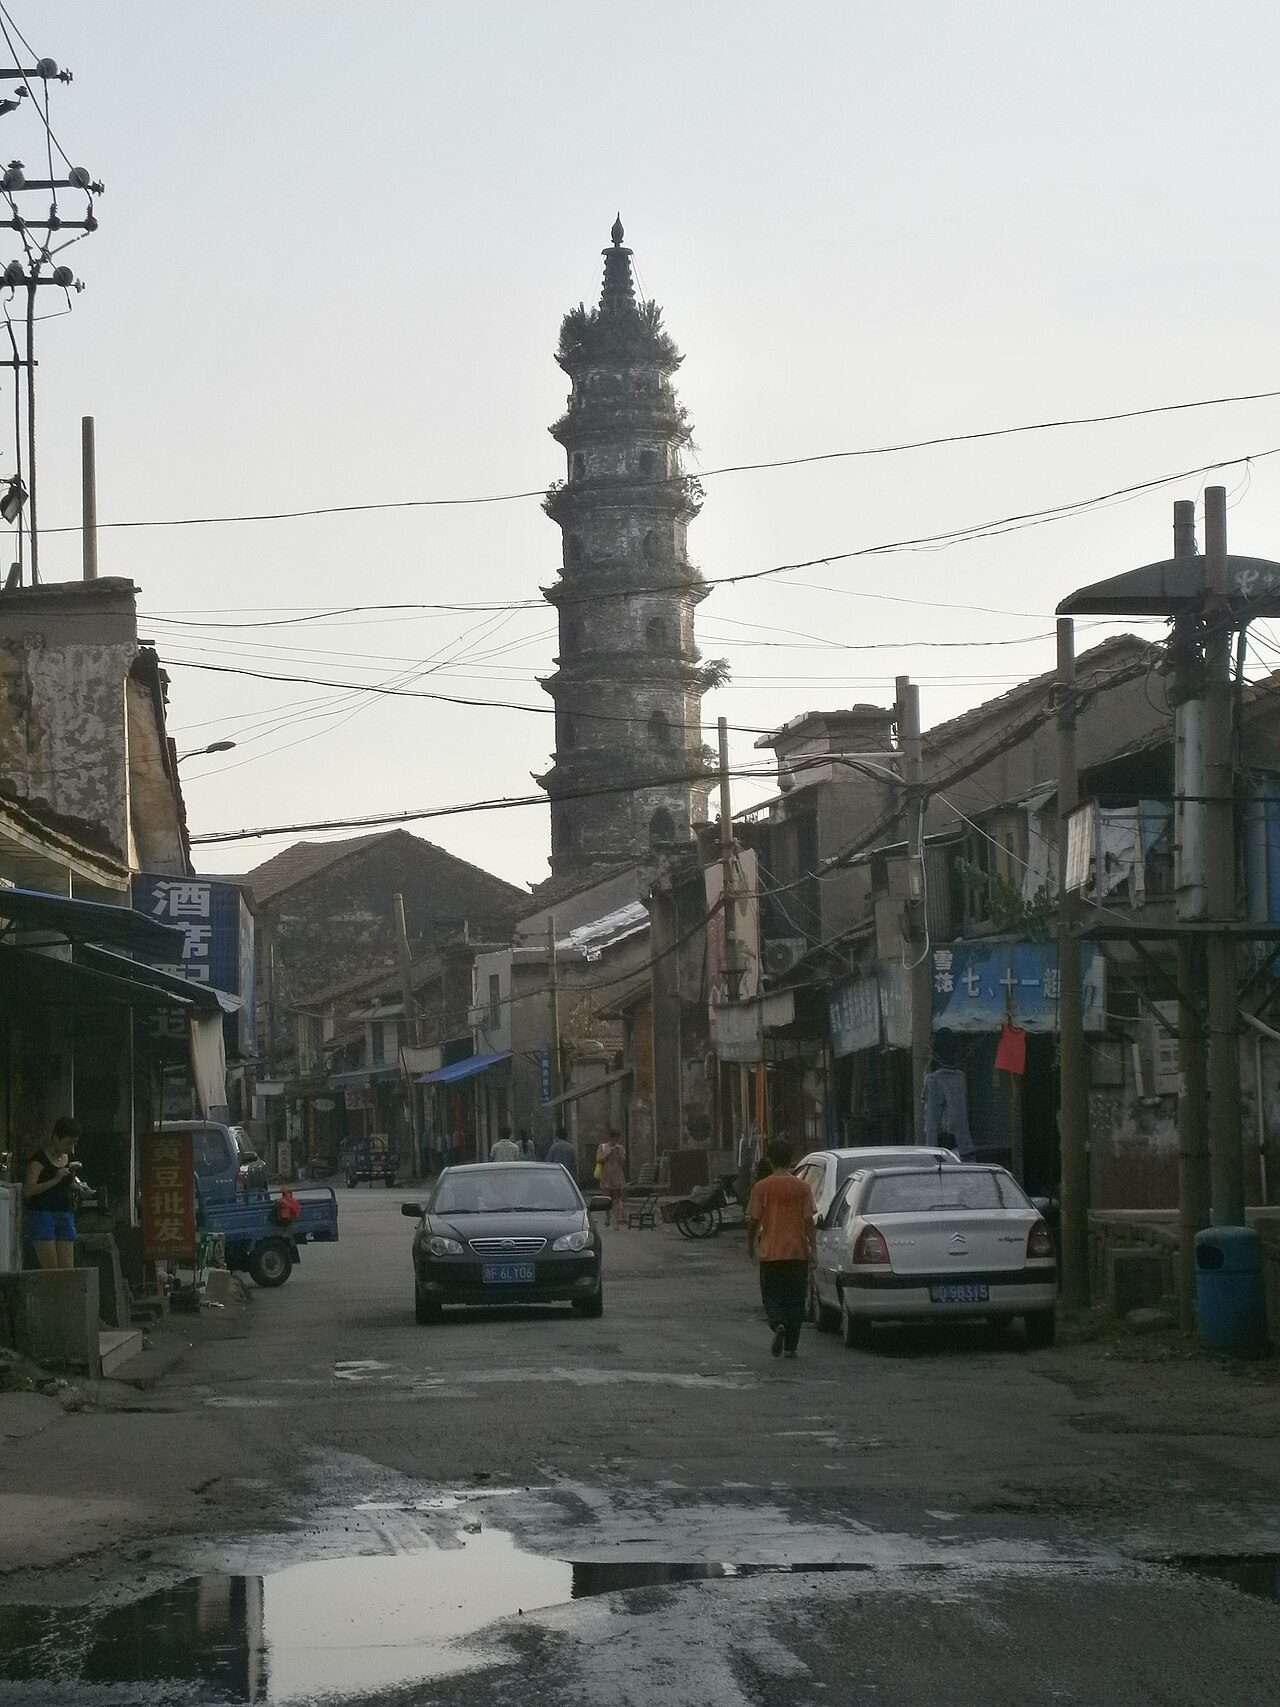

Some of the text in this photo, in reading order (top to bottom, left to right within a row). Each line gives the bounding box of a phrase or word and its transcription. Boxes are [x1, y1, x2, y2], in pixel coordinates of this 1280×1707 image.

[933, 949, 955, 994] 雪花
[151, 1137, 186, 1242] 黄豆批发
